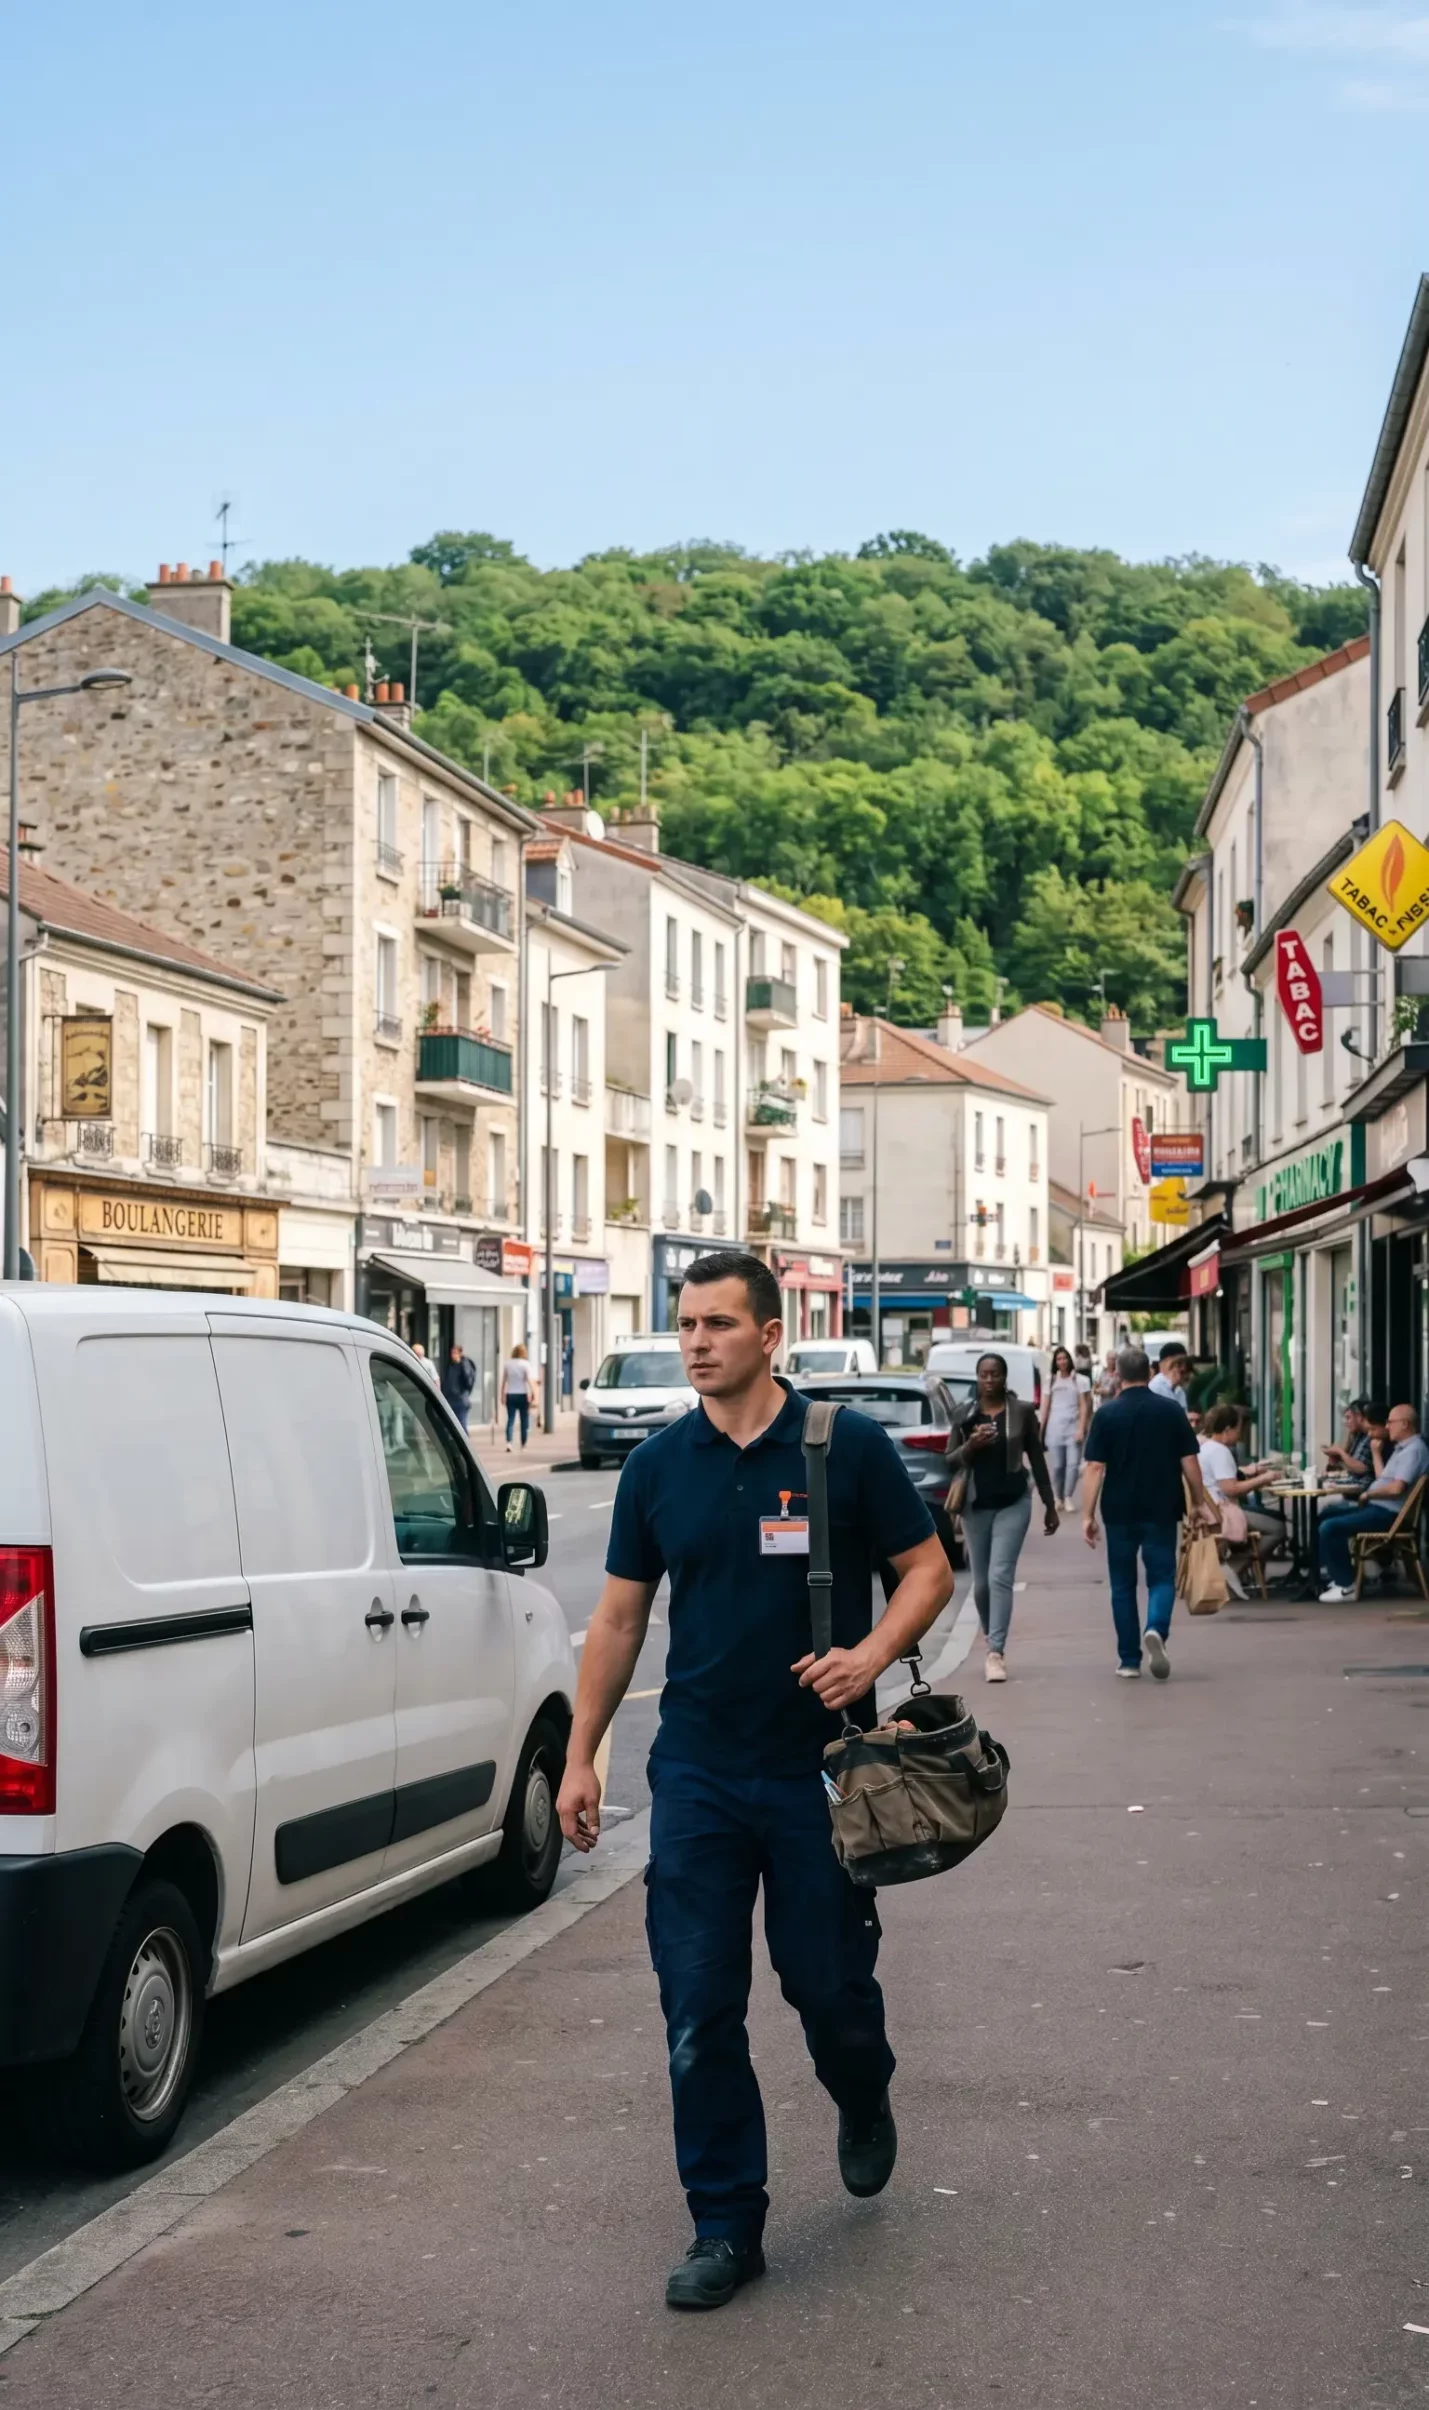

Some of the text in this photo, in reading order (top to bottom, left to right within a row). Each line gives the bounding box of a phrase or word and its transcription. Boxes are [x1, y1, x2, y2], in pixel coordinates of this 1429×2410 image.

[1340, 877, 1388, 928] TABAC
[1280, 938, 1319, 1042] TABAC
[103, 1201, 223, 1239] BOULANGERIE
